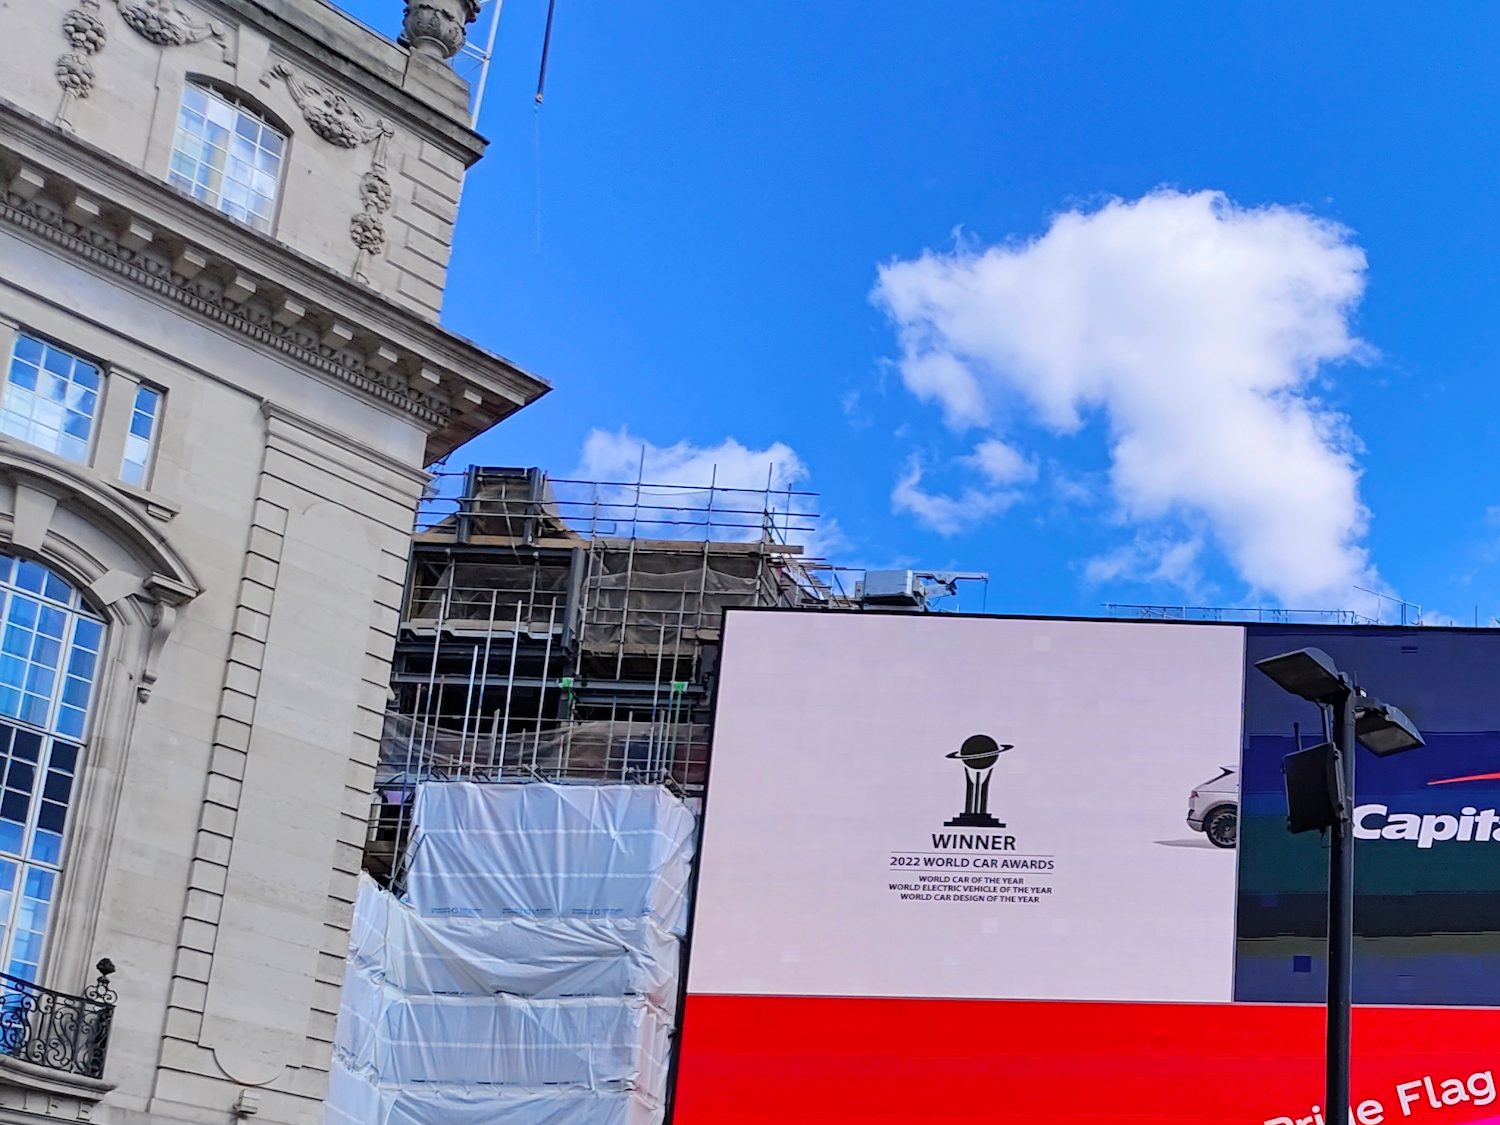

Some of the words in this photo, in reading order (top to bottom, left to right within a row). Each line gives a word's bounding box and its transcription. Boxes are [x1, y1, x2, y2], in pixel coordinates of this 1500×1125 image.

[932, 833, 1016, 850] WINNER
[889, 856, 920, 867] 2022
[923, 857, 970, 868] WORLD
[973, 858, 998, 868] CAR
[1000, 859, 1055, 870] AWARDS
[919, 875, 950, 883] WORLD
[971, 876, 983, 884] OF
[1002, 877, 1024, 885] YEAR
[889, 883, 920, 891] WORLD
[922, 884, 961, 892] ELECTRIC
[962, 885, 998, 893] VEHICLE
[1012, 886, 1029, 894] THE
[900, 893, 932, 901] WORLD
[952, 894, 985, 902] DESIGN
[1000, 895, 1017, 903] THE
[1395, 1070, 1497, 1117] Flag
